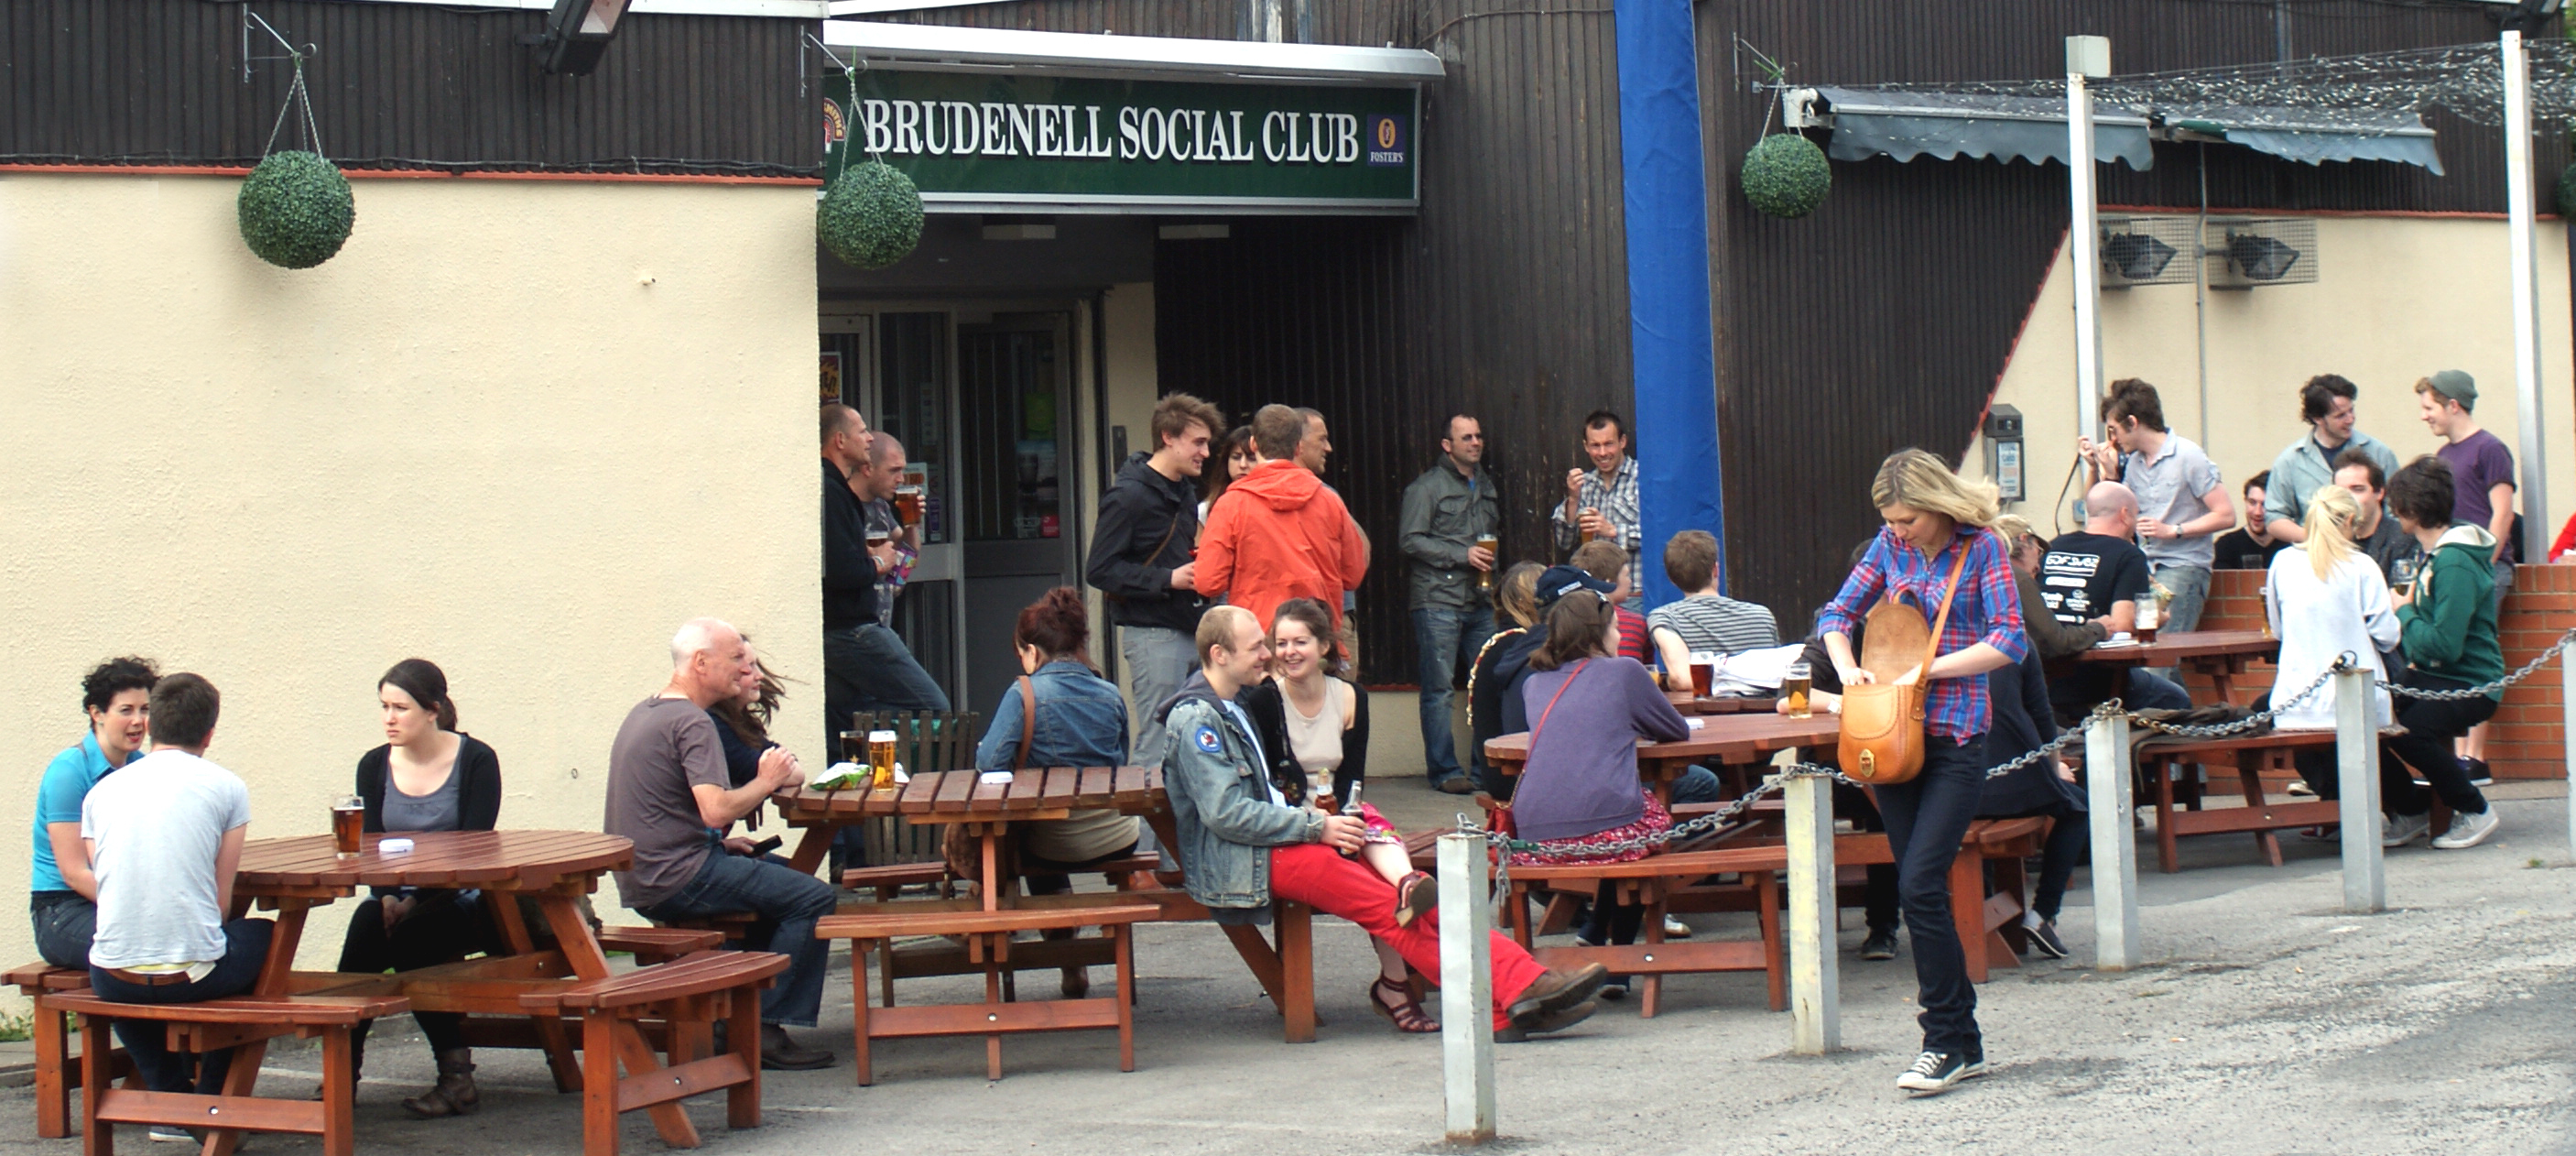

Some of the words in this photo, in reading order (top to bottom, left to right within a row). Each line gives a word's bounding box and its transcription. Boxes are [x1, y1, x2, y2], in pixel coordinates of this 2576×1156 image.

[864, 99, 1112, 158] BRUDENELL
[1119, 106, 1254, 161] SOCIAL
[1262, 111, 1359, 163] CLUB
